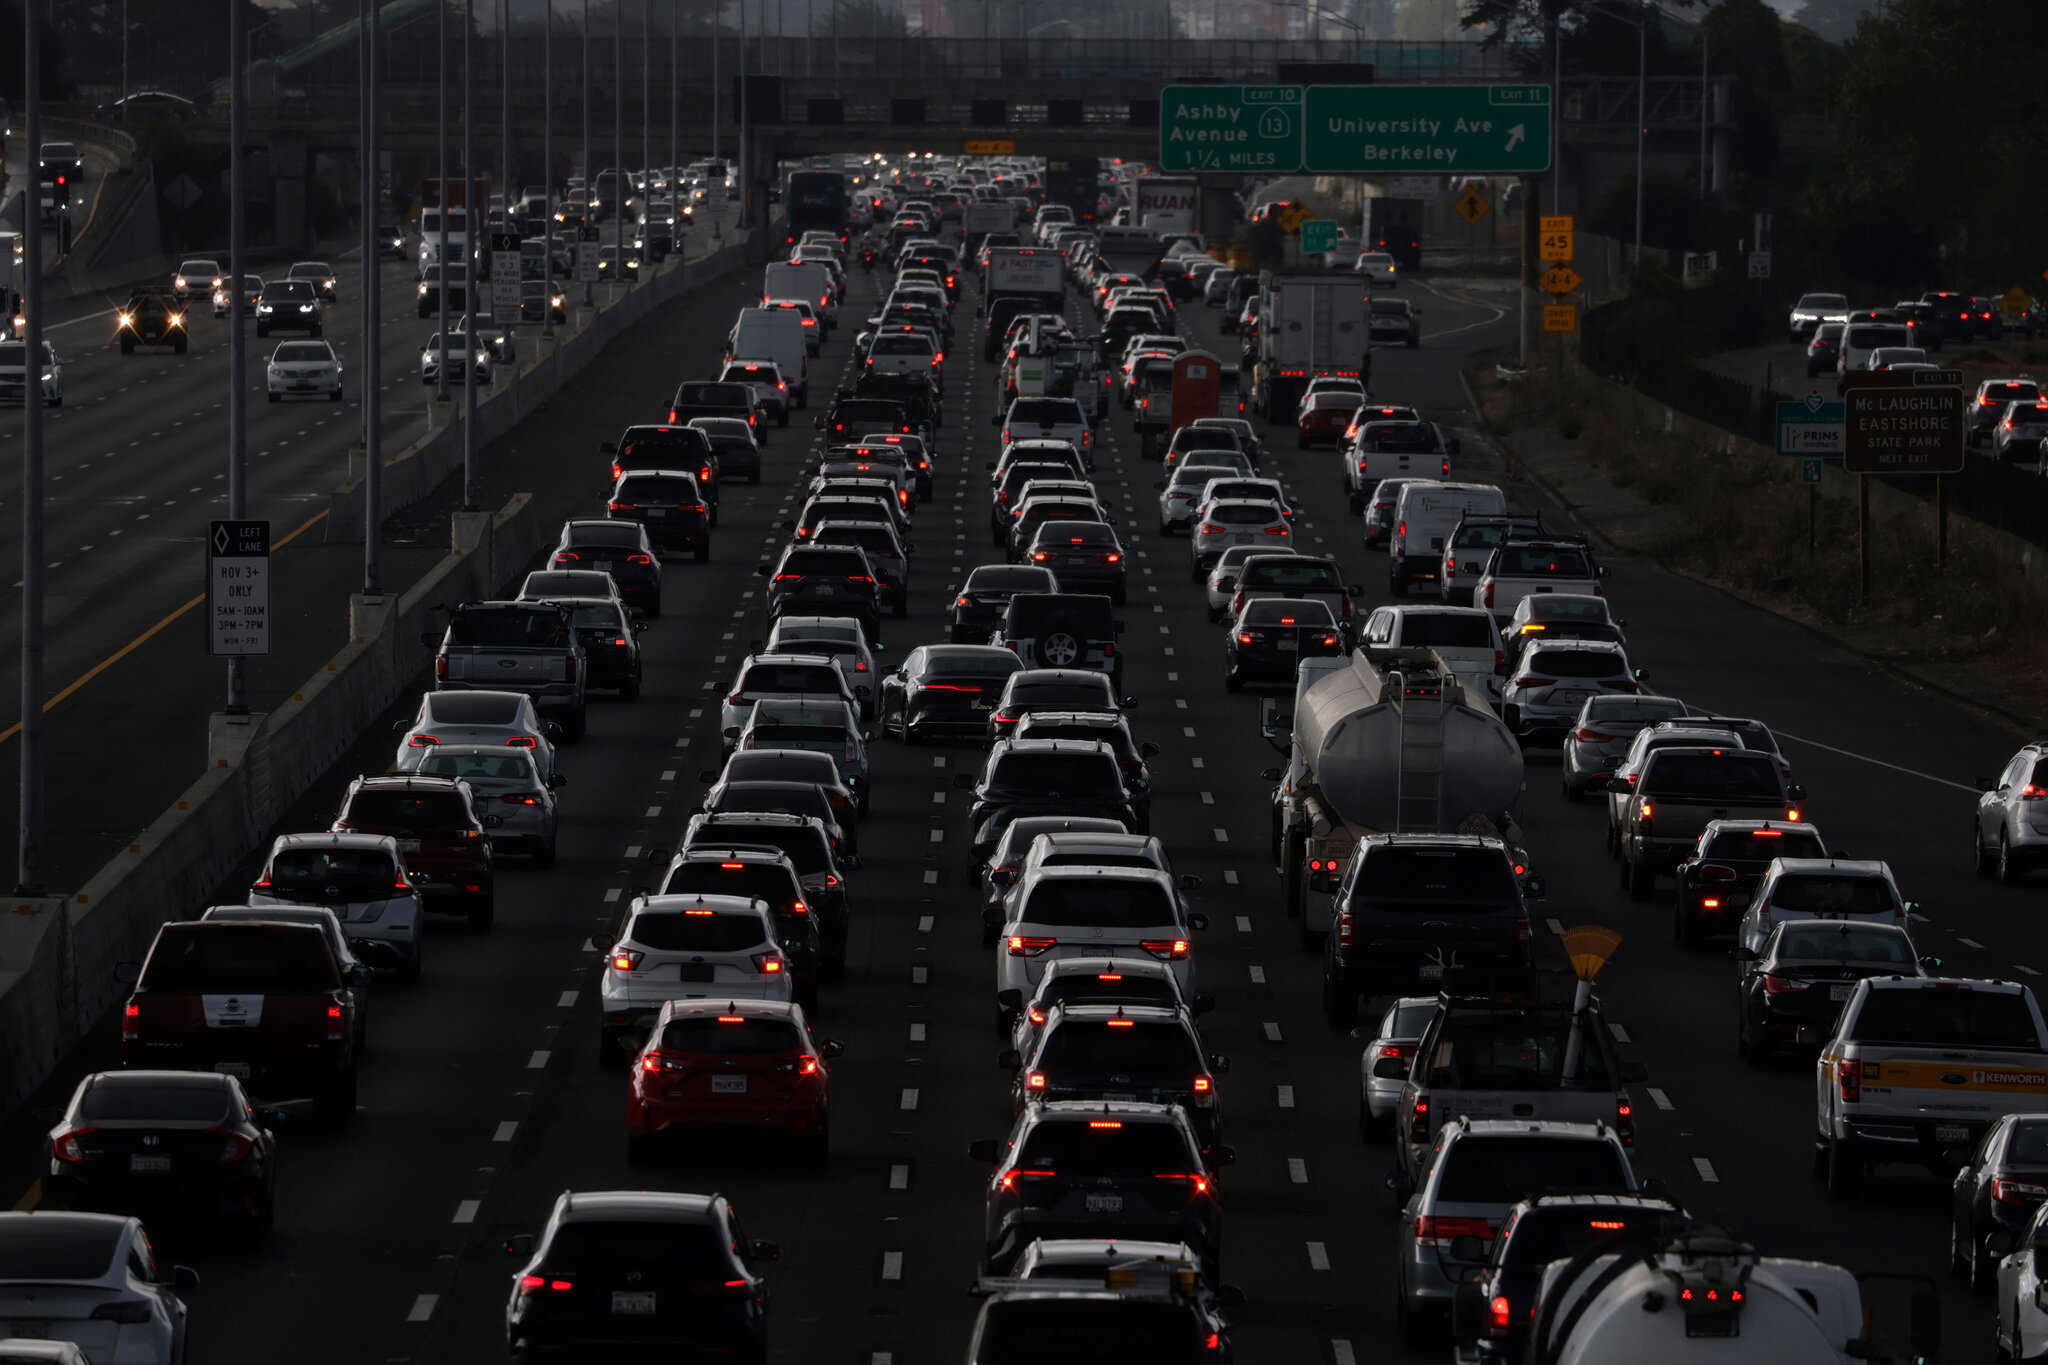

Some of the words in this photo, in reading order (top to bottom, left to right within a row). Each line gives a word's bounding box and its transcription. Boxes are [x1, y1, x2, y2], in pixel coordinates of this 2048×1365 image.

[1250, 90, 1273, 100] EXIT
[1279, 88, 1295, 101] 10
[1500, 90, 1523, 100] EXIT
[1529, 89, 1541, 101] 11
[1175, 104, 1241, 123] Ashby
[1266, 117, 1283, 133] 13
[1328, 117, 1440, 138] University
[1454, 117, 1492, 133] Ave
[1169, 127, 1249, 142] Avenue
[1229, 152, 1276, 165] MILES
[1364, 144, 1458, 164] Berkeley
[1139, 195, 1193, 210] RUAN
[1546, 220, 1566, 228] EXIT
[1307, 226, 1331, 235] EXIT
[1544, 235, 1568, 249] 45
[1009, 259, 1033, 267] FAST
[1751, 265, 1768, 276] 35
[1546, 274, 1571, 286] 14-4
[1923, 375, 1942, 383] EXIT
[1947, 373, 1957, 383] 11
[1855, 398, 1873, 410] Mc
[1879, 397, 1953, 411] LAUGHLIN
[1859, 417, 1949, 431] EASTSHORE
[1803, 431, 1839, 441] PRINS
[1867, 437, 1902, 448] STATE
[1908, 437, 1941, 448] PARK
[1879, 454, 1902, 464] NEXT
[1908, 454, 1929, 464] EXIT
[239, 527, 261, 538] LEFT
[239, 541, 262, 552] LANE
[221, 566, 241, 578] HOV
[246, 566, 259, 578] 3+
[229, 585, 253, 597] ONLY
[1986, 1072, 2046, 1085] KENWORTH
